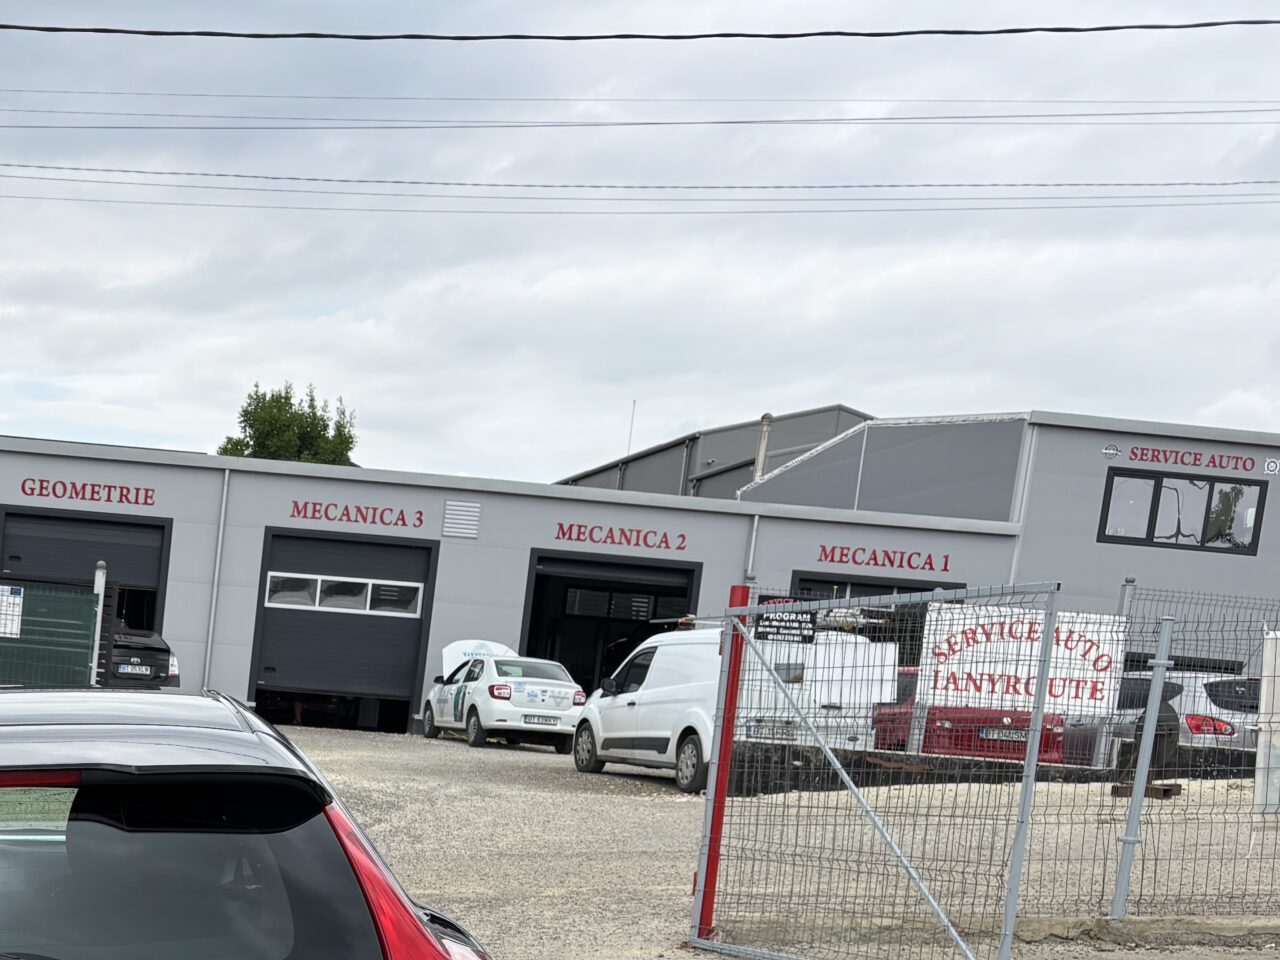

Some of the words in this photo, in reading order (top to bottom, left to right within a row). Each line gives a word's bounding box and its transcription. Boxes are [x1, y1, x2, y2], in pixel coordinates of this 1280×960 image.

[1129, 446, 1203, 467] SERVICE
[1205, 454, 1256, 472] AUTO
[21, 477, 156, 507] GEOMETRIE
[289, 500, 408, 527] MECANICA
[412, 510, 424, 528] 3
[554, 522, 671, 550] MECANICA
[675, 533, 687, 551] 2
[816, 544, 936, 571] MECANICA
[940, 554, 950, 572] 1
[931, 619, 1041, 665] SERVICE
[930, 669, 1106, 702] IANYROUTE
